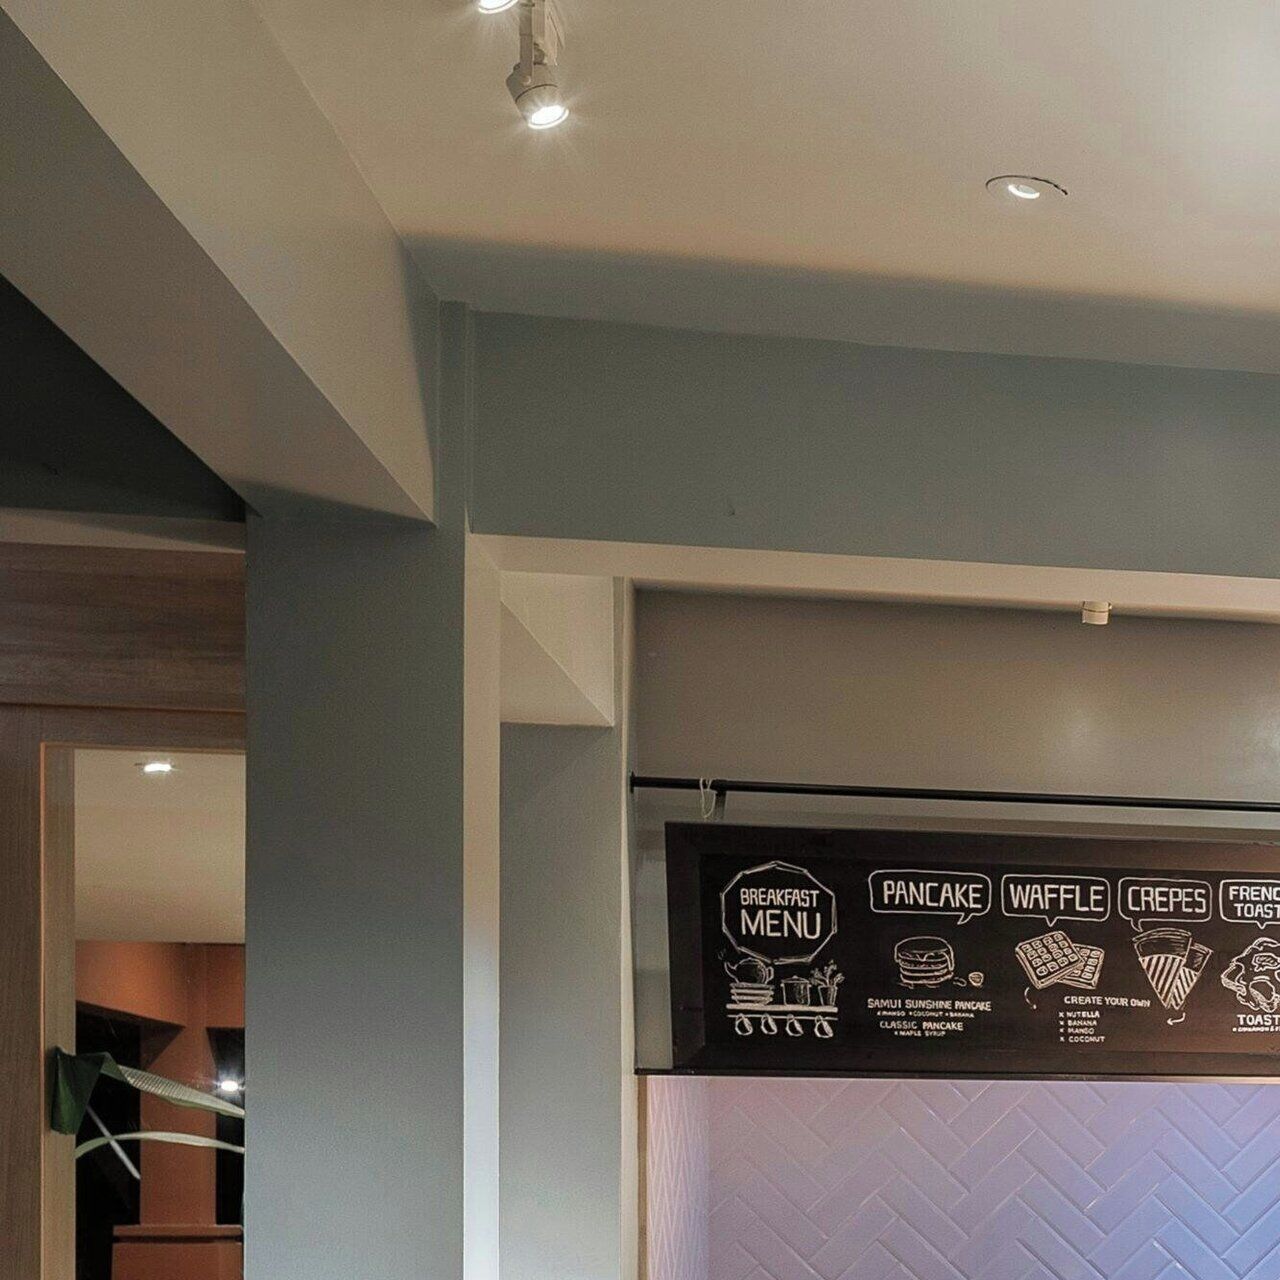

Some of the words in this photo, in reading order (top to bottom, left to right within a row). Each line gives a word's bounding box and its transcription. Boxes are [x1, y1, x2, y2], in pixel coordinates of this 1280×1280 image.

[740, 888, 820, 908] BREAKFAST
[884, 880, 982, 908] PANCAKE
[1010, 883, 1104, 912] WAFFLE
[1128, 886, 1206, 913] CREPES
[740, 910, 821, 939] MENU
[868, 998, 901, 1008] SAMUI
[905, 999, 952, 1010] SUNSHINE
[955, 1001, 992, 1012] PANCAKE
[1064, 996, 1102, 1005] CREATE
[1104, 997, 1128, 1006] YOUR
[1130, 999, 1151, 1007] OWN
[1066, 1010, 1100, 1018] NUTELLA
[880, 1020, 918, 1029] CLASSIC
[922, 1021, 964, 1031] PANCAKE
